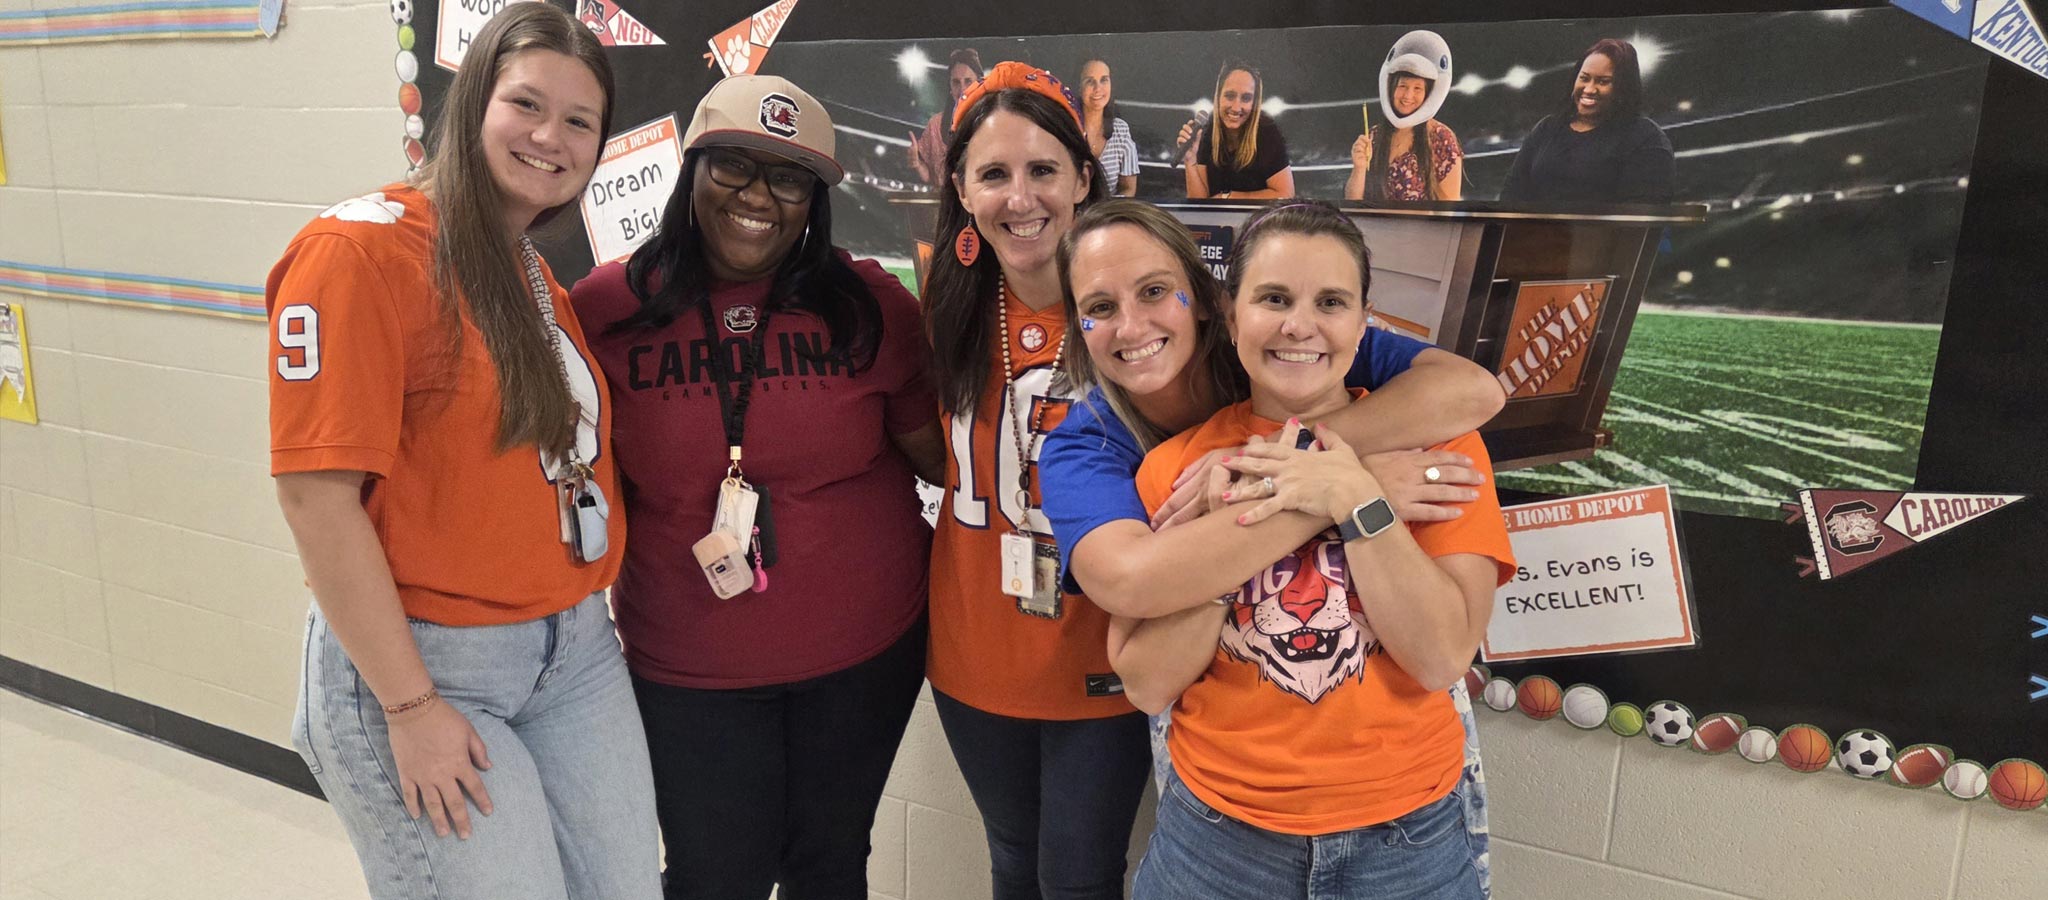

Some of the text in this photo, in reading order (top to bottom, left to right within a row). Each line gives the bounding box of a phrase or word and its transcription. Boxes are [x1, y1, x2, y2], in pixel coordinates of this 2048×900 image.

[615, 13, 654, 44] NGU
[629, 125, 666, 150] DEPOT
[591, 163, 663, 207] Dream
[277, 304, 321, 382] 9
[1497, 282, 1600, 397] HOME
[1529, 325, 1590, 394] DEPOT
[1516, 503, 1573, 527] HOME
[1577, 494, 1646, 519] DEPOT
[1547, 554, 1621, 579] Evans
[1631, 548, 1655, 568] is
[1506, 584, 1645, 614] EXCELLENT!
